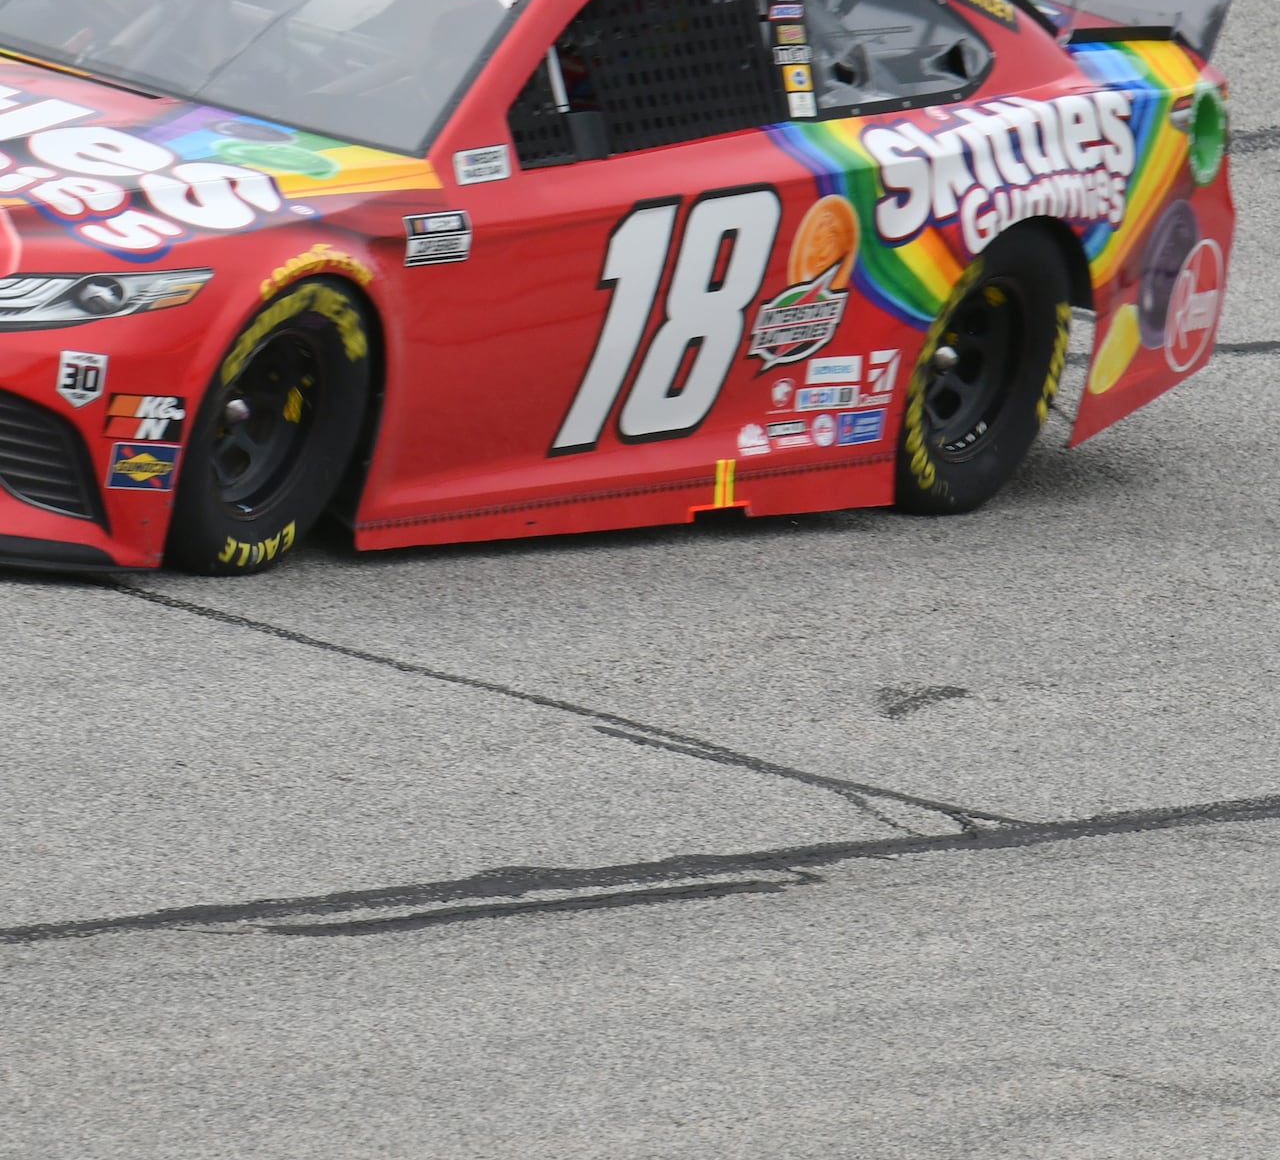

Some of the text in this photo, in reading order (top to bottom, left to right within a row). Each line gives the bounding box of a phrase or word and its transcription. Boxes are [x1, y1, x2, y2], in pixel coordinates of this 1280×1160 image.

[862, 90, 1137, 240] Skittles
[963, 169, 1127, 256] Gummies
[547, 182, 783, 458] 18
[756, 299, 841, 327] INTERSTATE
[756, 321, 831, 347] BATTERIES
[61, 362, 101, 392] 30
